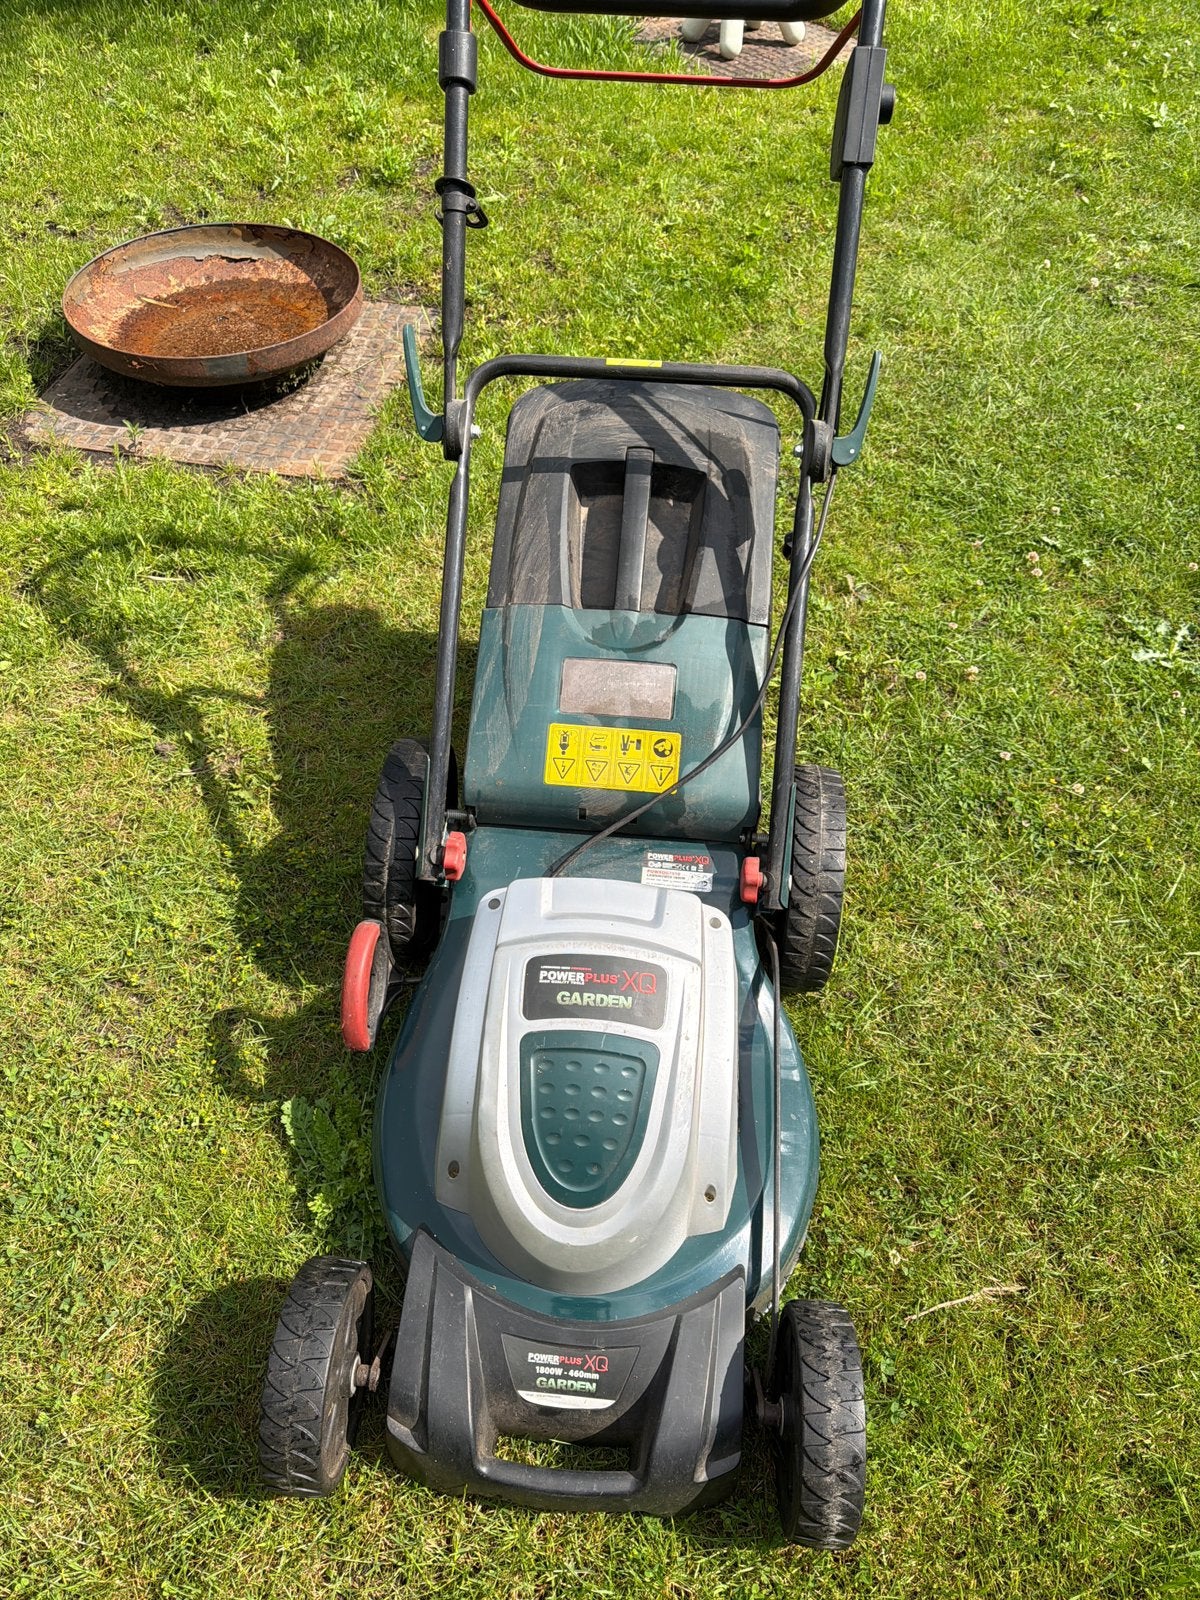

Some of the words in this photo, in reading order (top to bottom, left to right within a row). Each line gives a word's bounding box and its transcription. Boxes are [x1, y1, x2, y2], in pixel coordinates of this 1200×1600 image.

[620, 970, 657, 994] XQ
[556, 991, 633, 1009] GARDEN
[583, 1354, 608, 1372] XQ
[535, 1366, 563, 1376] 1800W
[568, 1370, 600, 1380] 460mm
[536, 1377, 597, 1393] GARDEN
